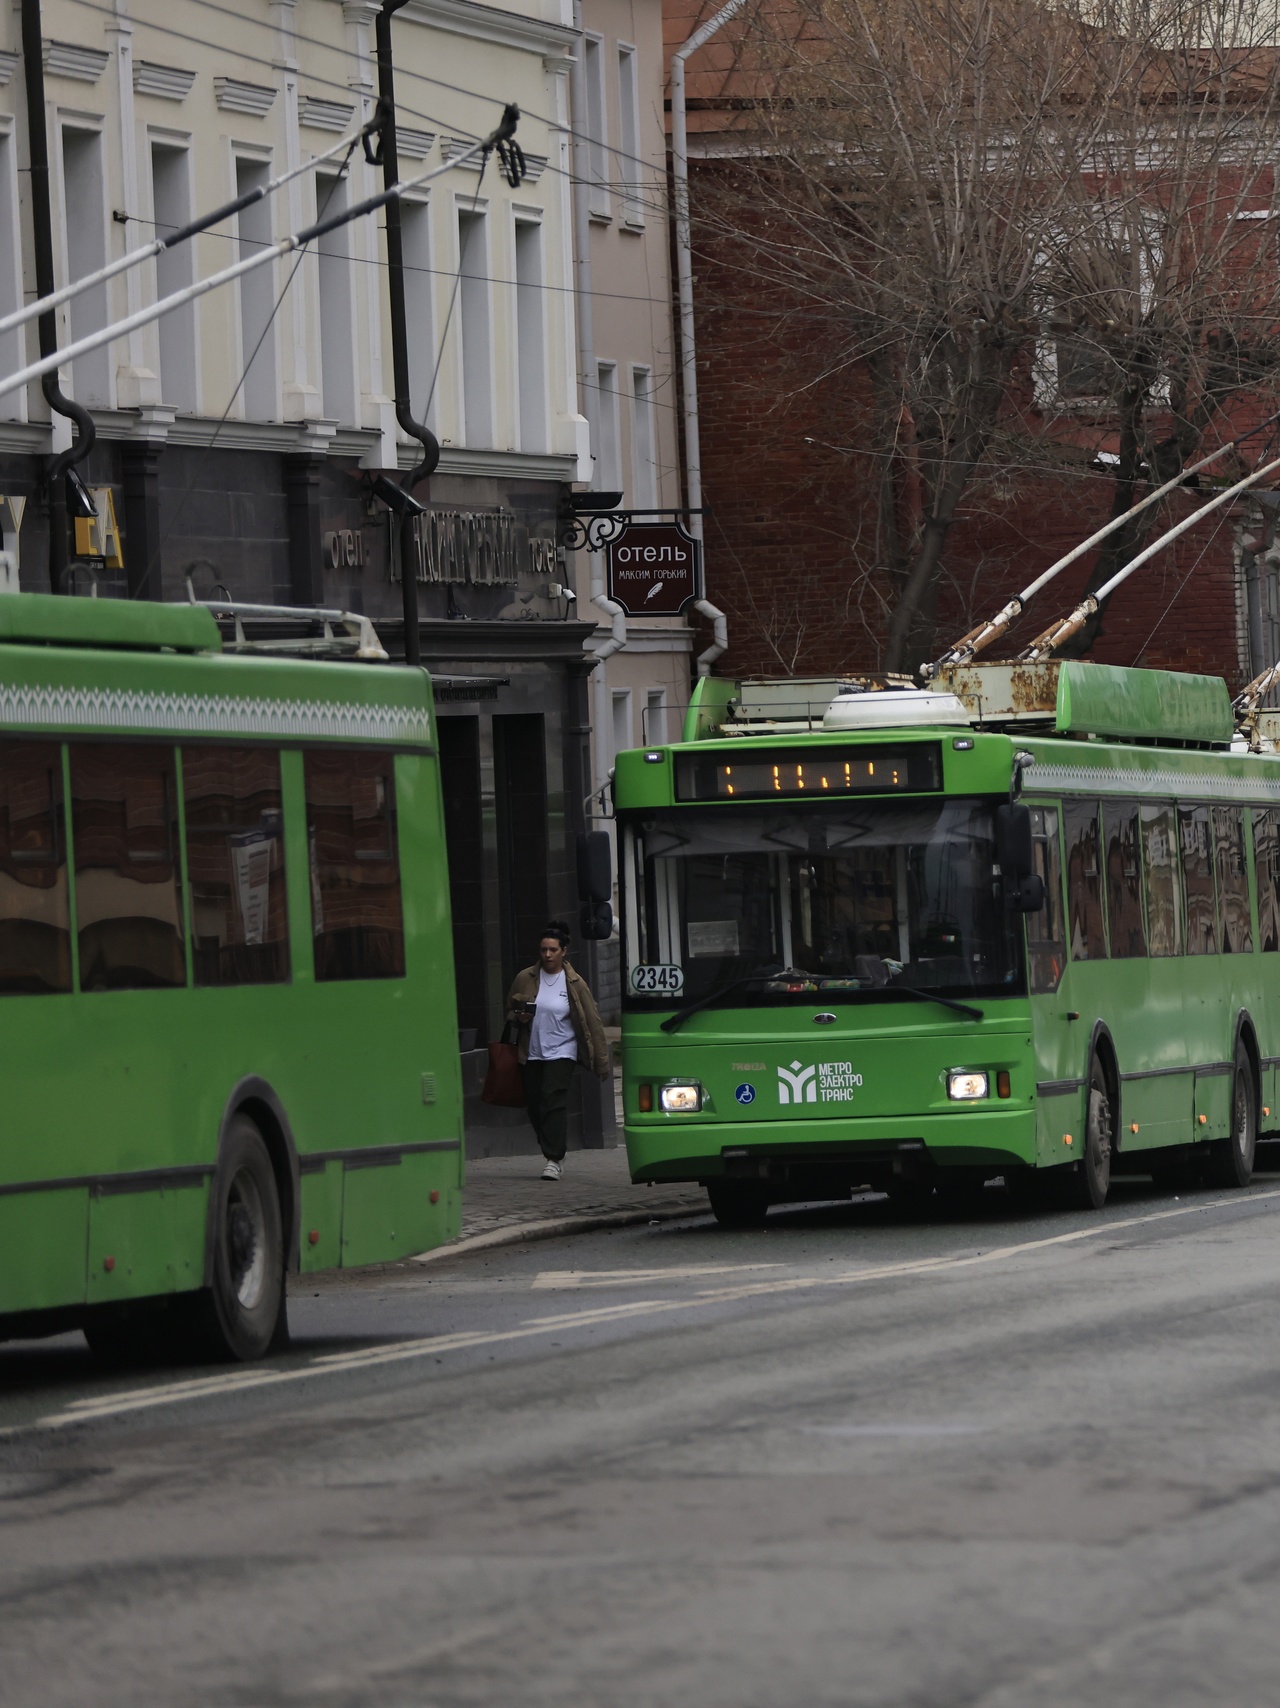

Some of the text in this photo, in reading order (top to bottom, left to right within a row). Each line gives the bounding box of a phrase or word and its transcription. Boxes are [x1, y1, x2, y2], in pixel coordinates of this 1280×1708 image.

[617, 546, 687, 562] отель
[619, 568, 687, 580] МАКСИМ ГОРЬКИЙ
[637, 968, 679, 989] 2345
[819, 1061, 853, 1076] МЕТРО
[820, 1074, 863, 1088] ЭЛЕКТРО
[820, 1088, 854, 1102] ТРАНС
